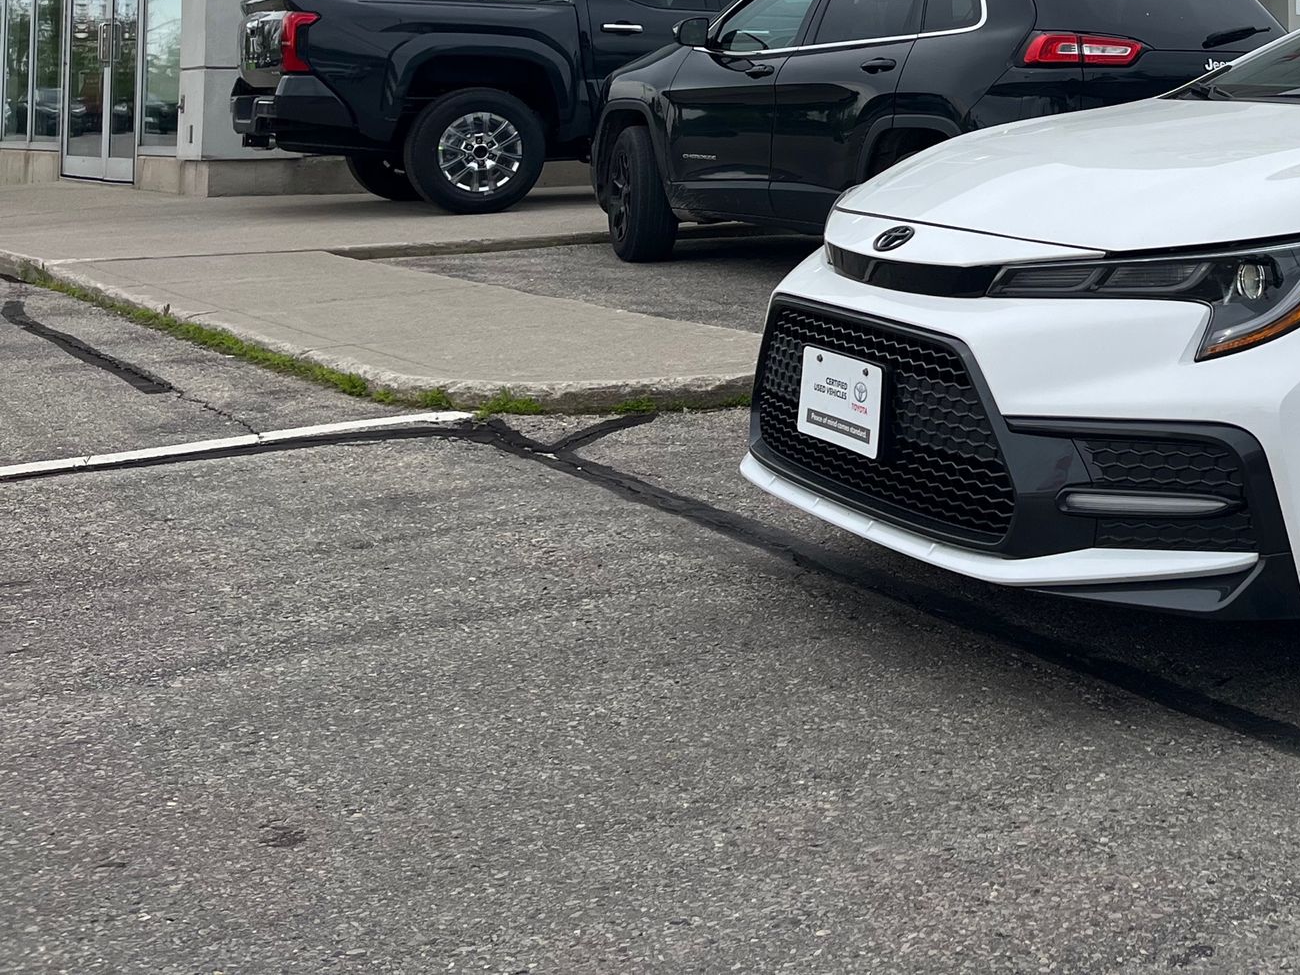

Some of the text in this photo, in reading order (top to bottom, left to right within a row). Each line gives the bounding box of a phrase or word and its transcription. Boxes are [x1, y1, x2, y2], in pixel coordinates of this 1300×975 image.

[1204, 58, 1231, 71] Jee
[826, 377, 848, 390] CERTIFIED
[814, 383, 847, 400] USED VEHICLES
[851, 403, 868, 415] TOYOTA
